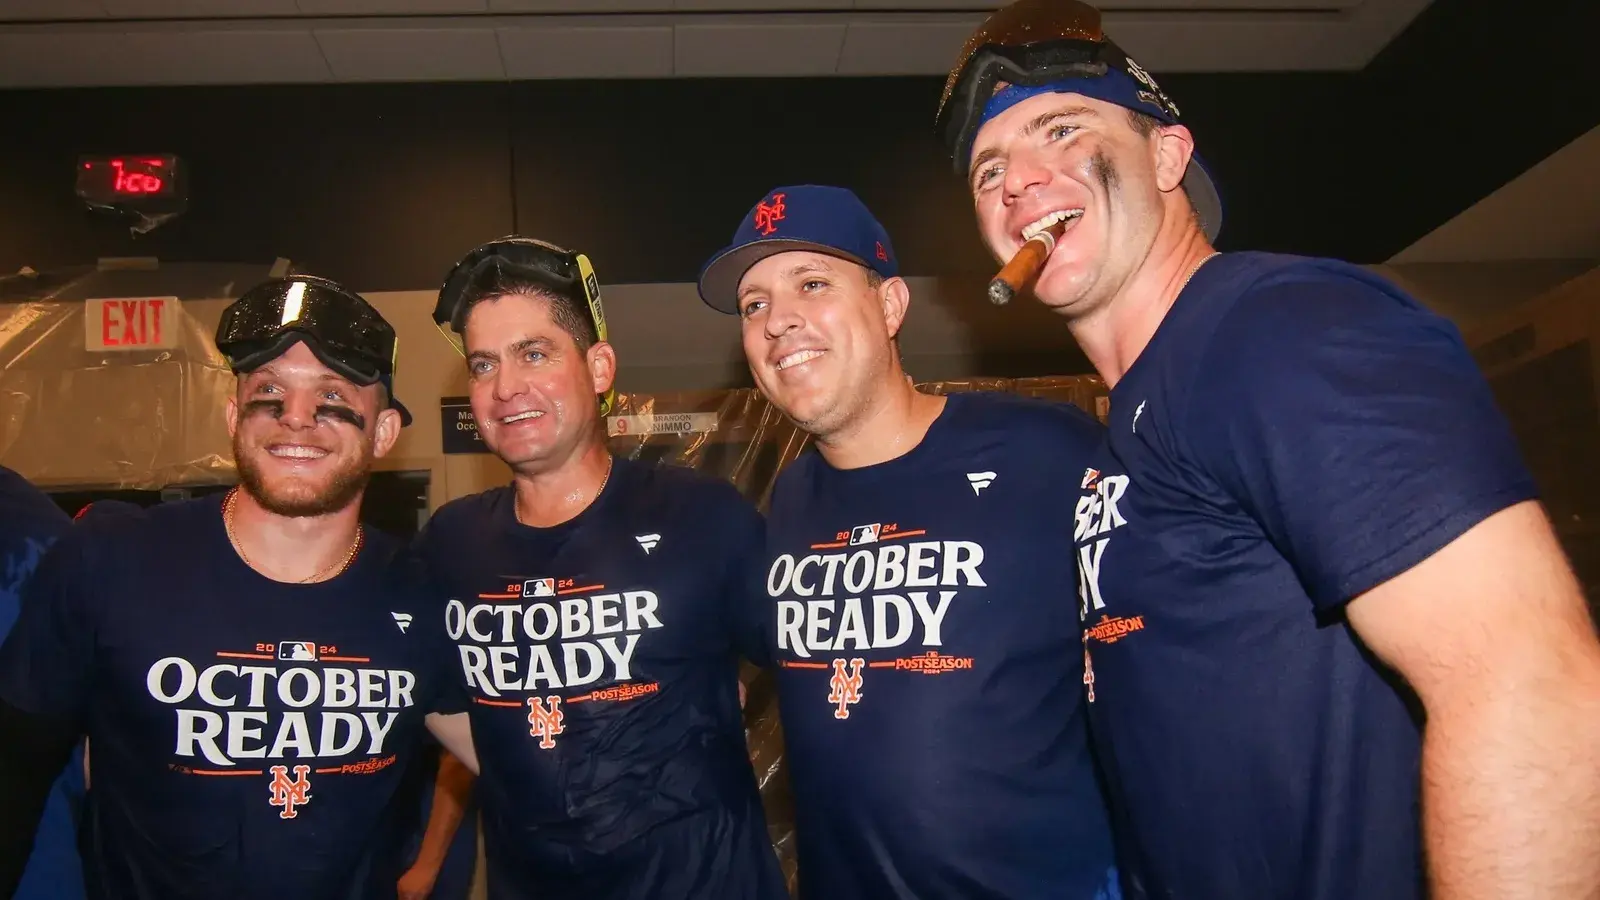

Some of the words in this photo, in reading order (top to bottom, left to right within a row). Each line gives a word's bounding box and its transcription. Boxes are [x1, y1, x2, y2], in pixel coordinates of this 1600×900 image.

[102, 300, 164, 346] EXIT
[458, 411, 474, 420] Ma
[456, 421, 478, 431] Occ
[616, 418, 628, 434] 9
[653, 421, 692, 432] NIMMO
[836, 531, 849, 540] 20
[882, 523, 898, 532] 24
[767, 540, 988, 598] OCTOBER
[507, 584, 521, 592] 20
[558, 579, 574, 588] 24
[445, 590, 664, 641] OCTOBER
[777, 590, 958, 658] READY
[256, 643, 275, 652] 20
[319, 645, 337, 654] 24
[458, 634, 642, 697] READY
[894, 657, 972, 670] POSTSEASON
[146, 656, 416, 708] OCTOBER
[592, 682, 658, 701] POSTSEASON
[175, 708, 399, 766] READY
[341, 754, 396, 774] POSTSEASON
